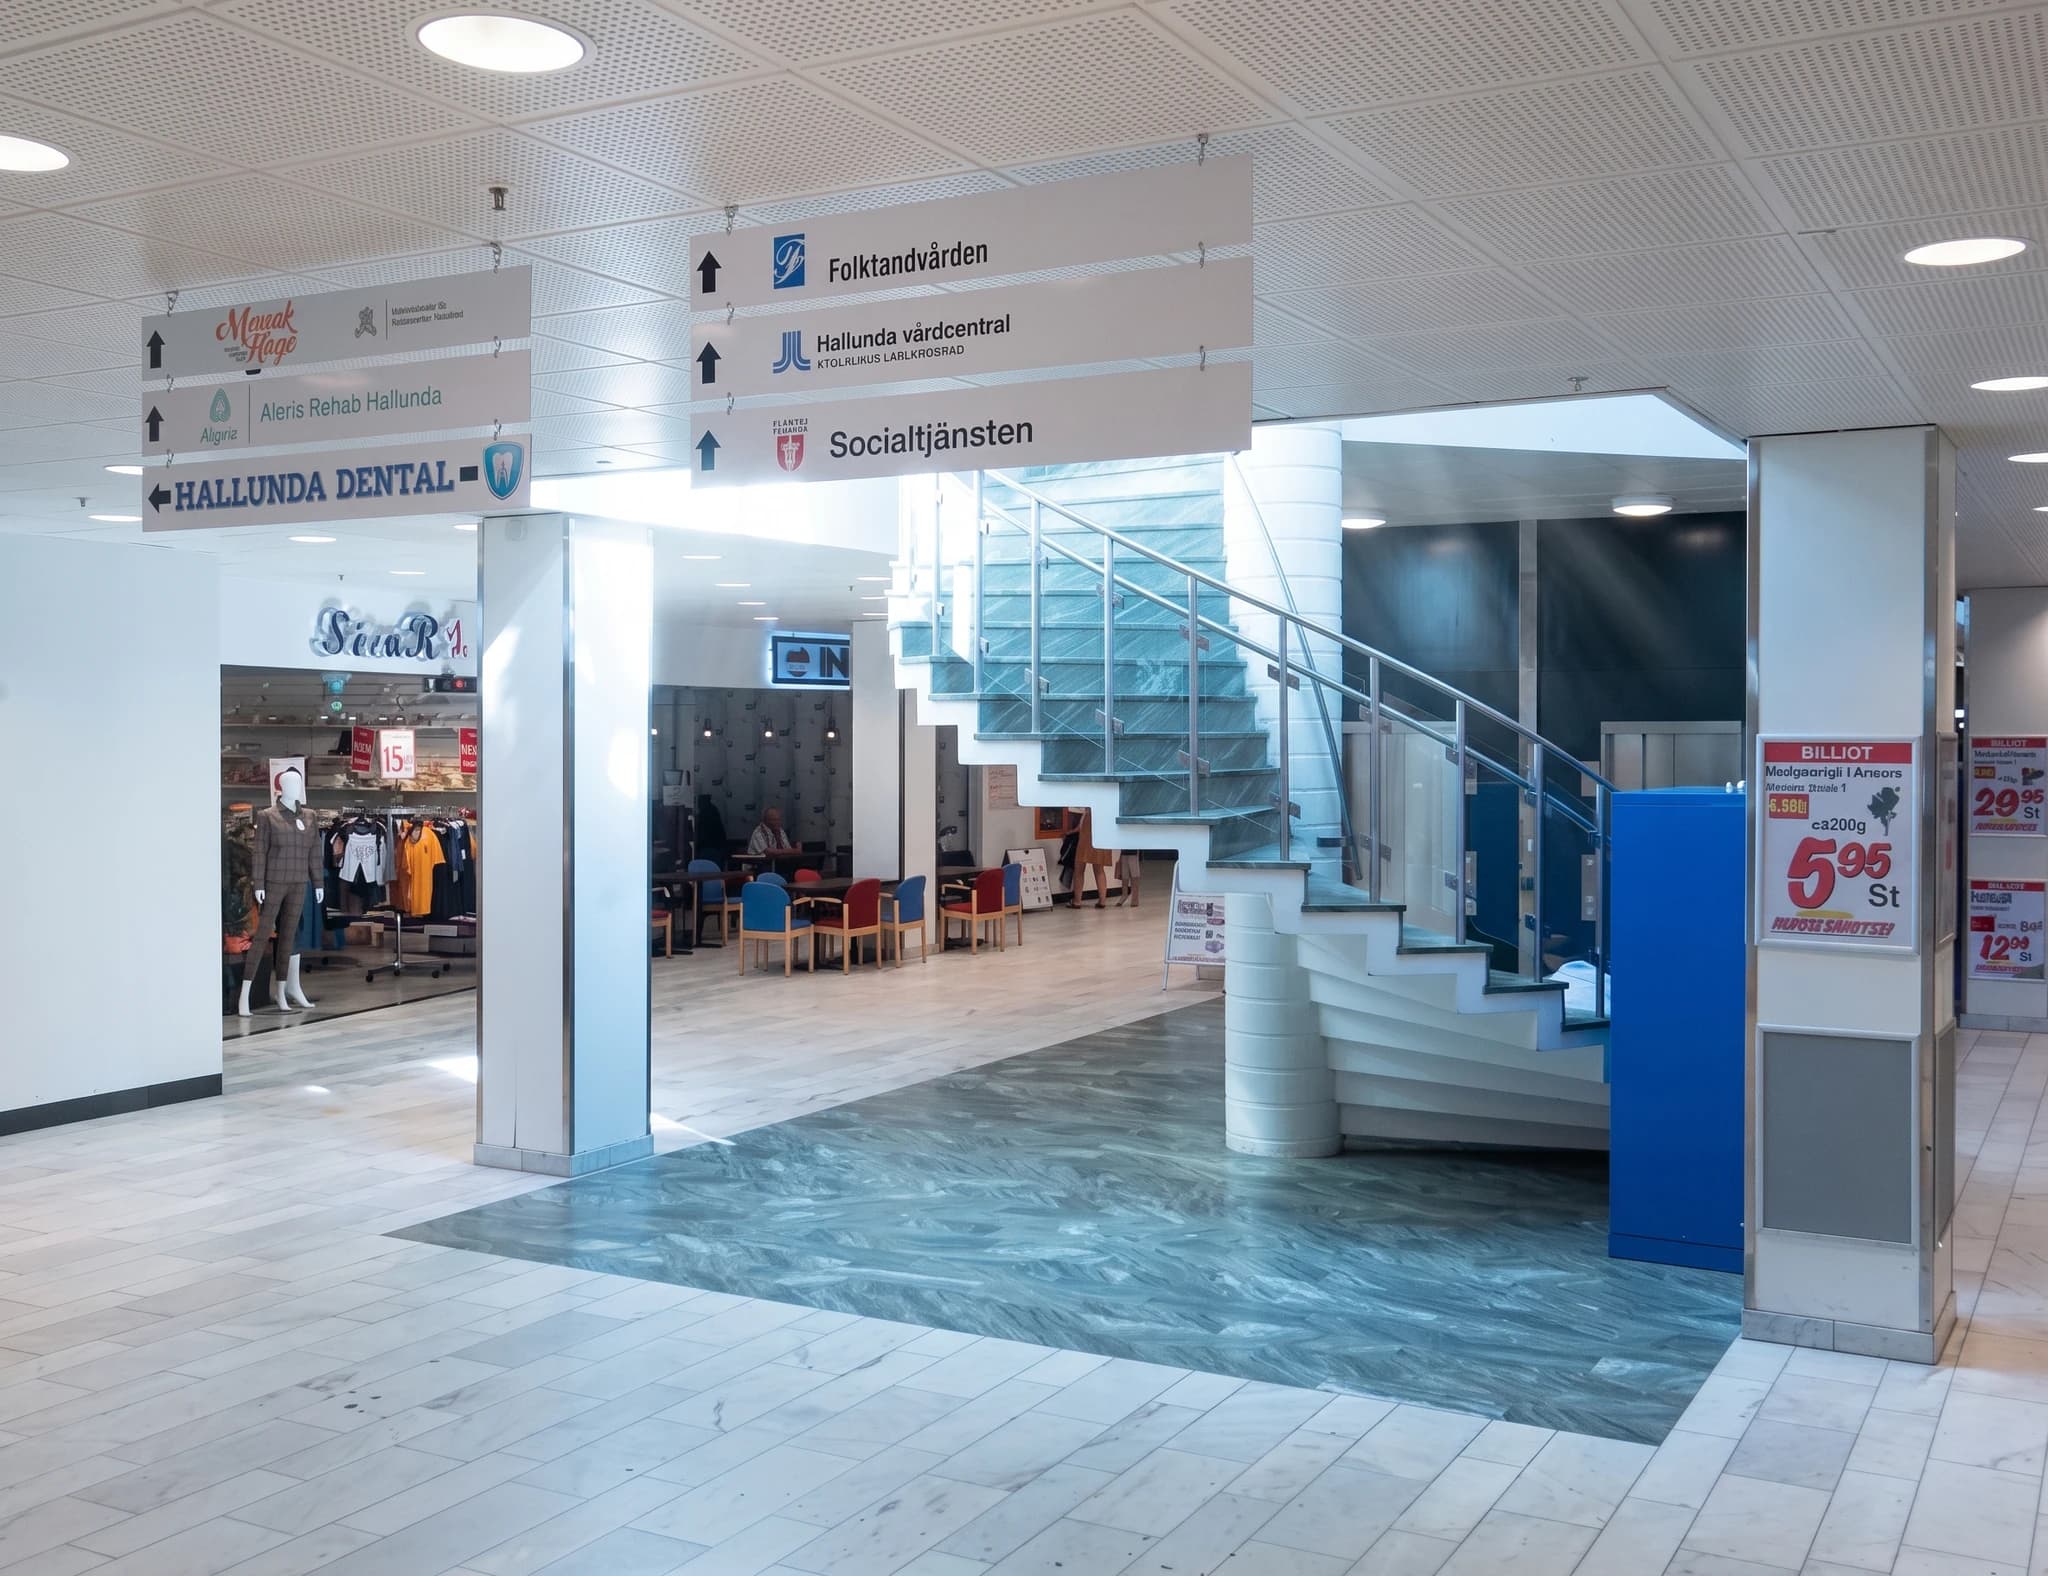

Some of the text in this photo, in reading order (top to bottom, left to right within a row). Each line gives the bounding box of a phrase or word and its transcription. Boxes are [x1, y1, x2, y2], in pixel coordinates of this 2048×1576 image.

[829, 241, 988, 283] Folktandvården
[817, 314, 1011, 353] Hallunda vårdcentral
[260, 385, 442, 422] Aleris Rehab Hallunda
[830, 420, 1033, 458] Socialtjänsten
[175, 460, 455, 512] HALLUNDA DENTAL
[383, 745, 404, 772] 15
[1802, 746, 1873, 760] BILLIOT
[1868, 883, 1901, 908] St
